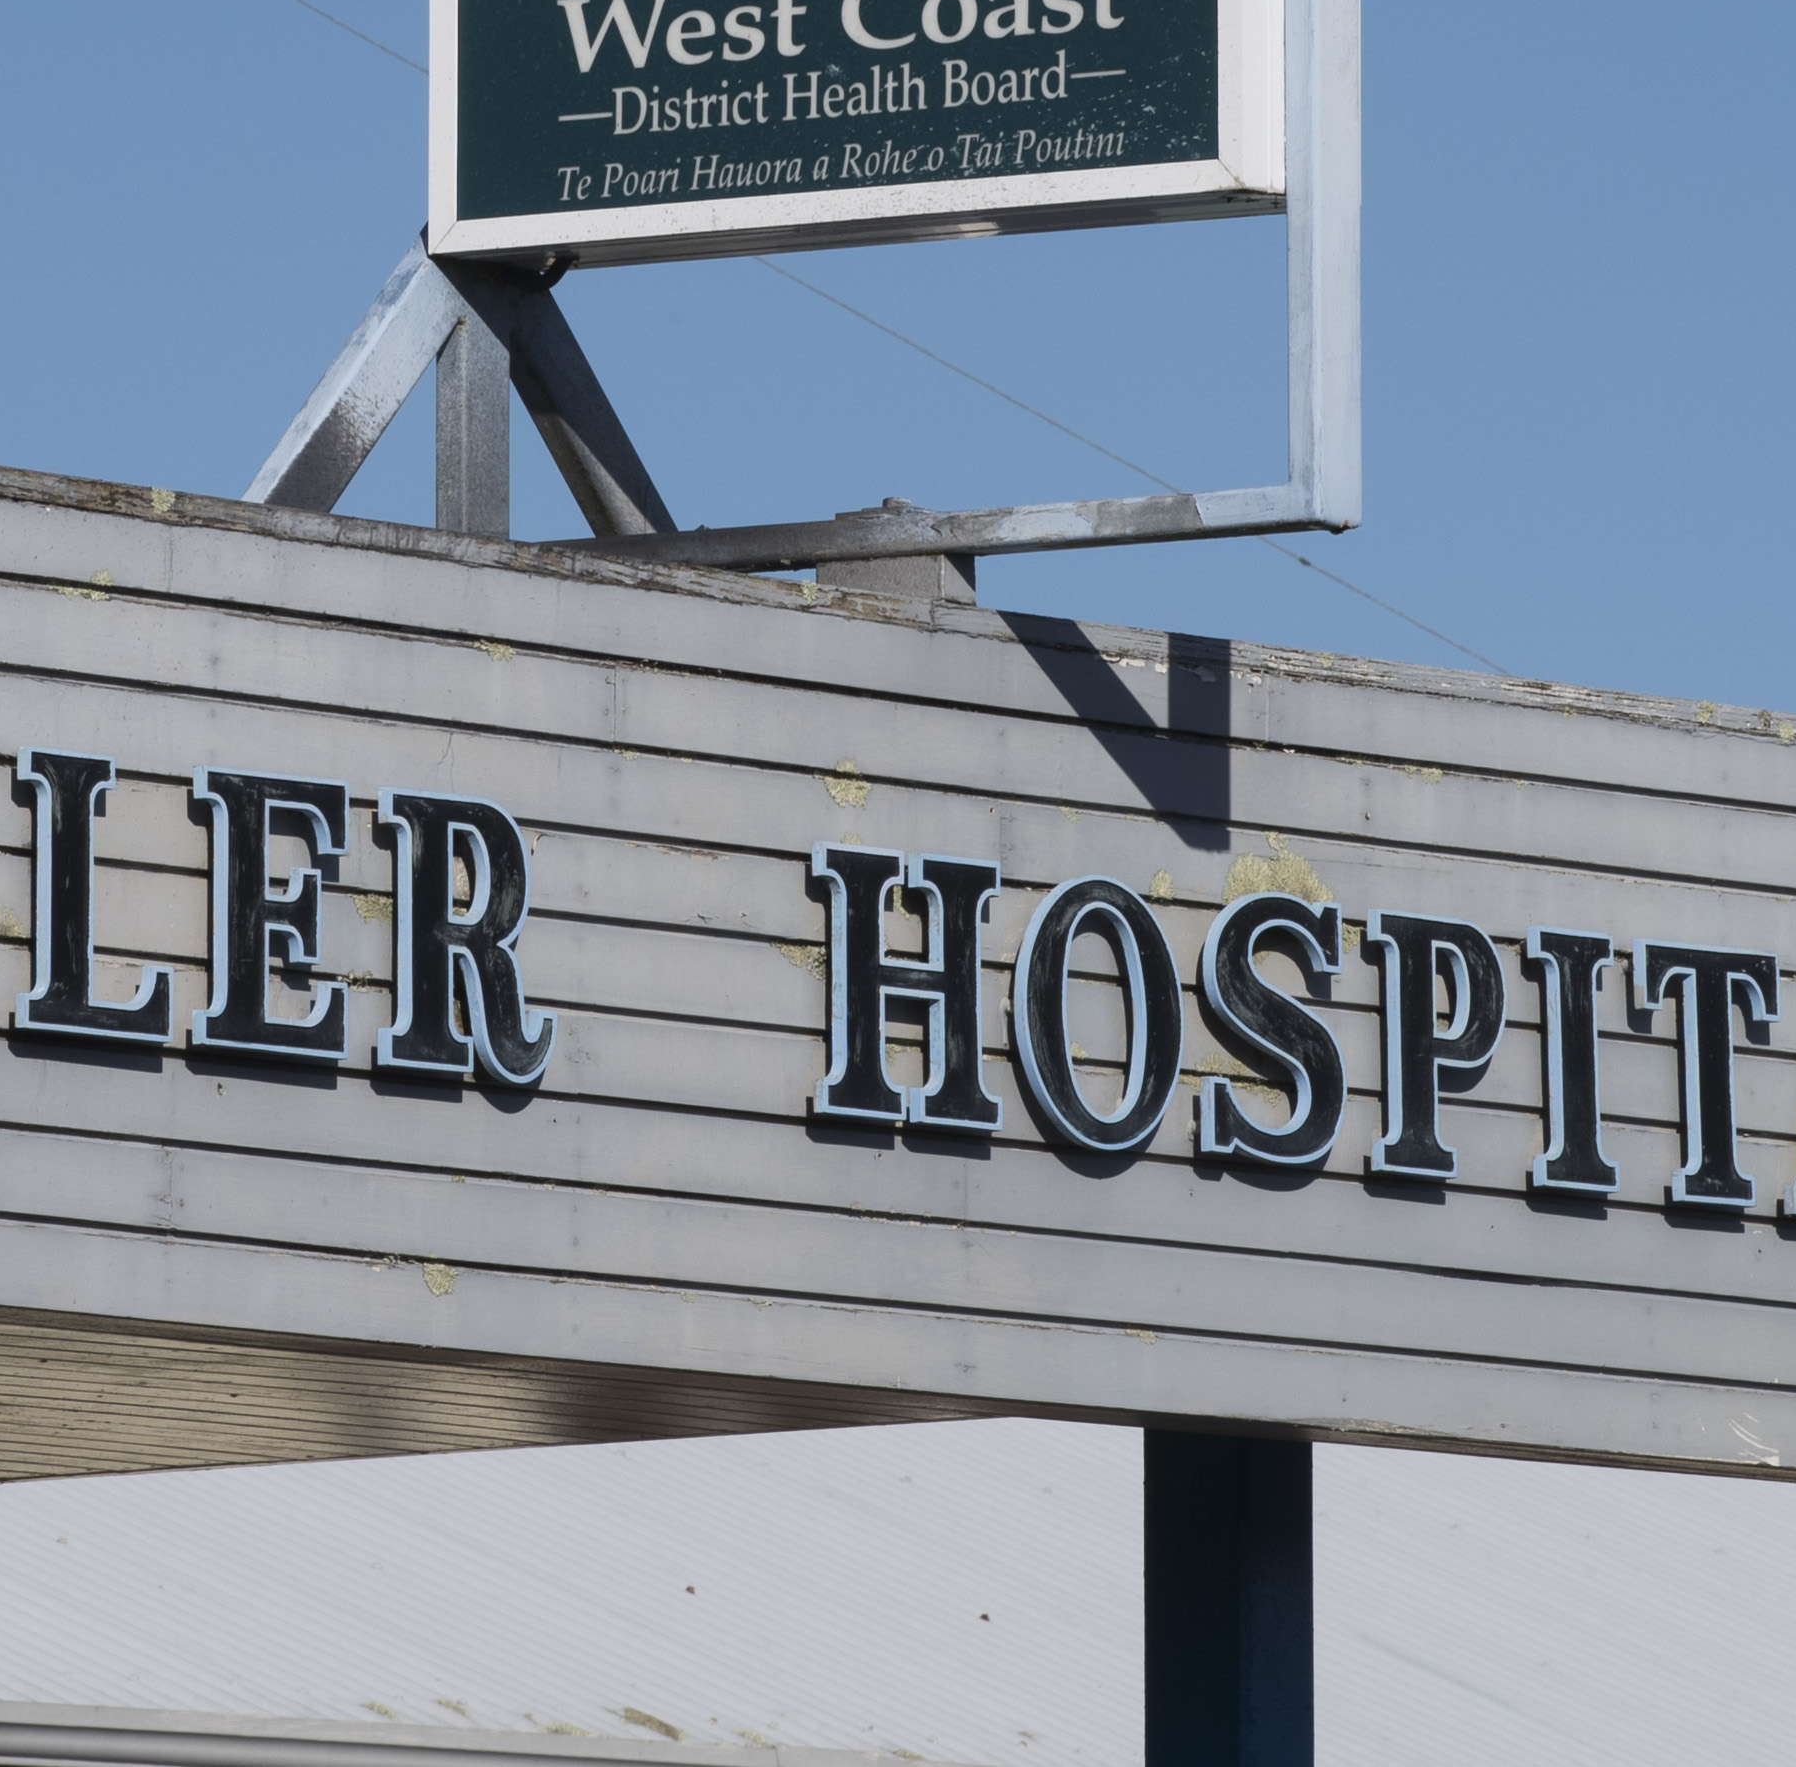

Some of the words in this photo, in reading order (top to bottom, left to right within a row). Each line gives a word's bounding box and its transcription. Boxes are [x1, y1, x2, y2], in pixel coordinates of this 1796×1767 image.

[781, 61, 927, 122] Health
[557, 166, 592, 201] Te
[600, 156, 681, 199] Poari
[689, 153, 803, 192] Hauora
[812, 154, 829, 181] a
[838, 139, 918, 180] Rohe
[926, 145, 946, 172] o
[956, 130, 1005, 170] Tai
[1012, 120, 1126, 167] Poutini
